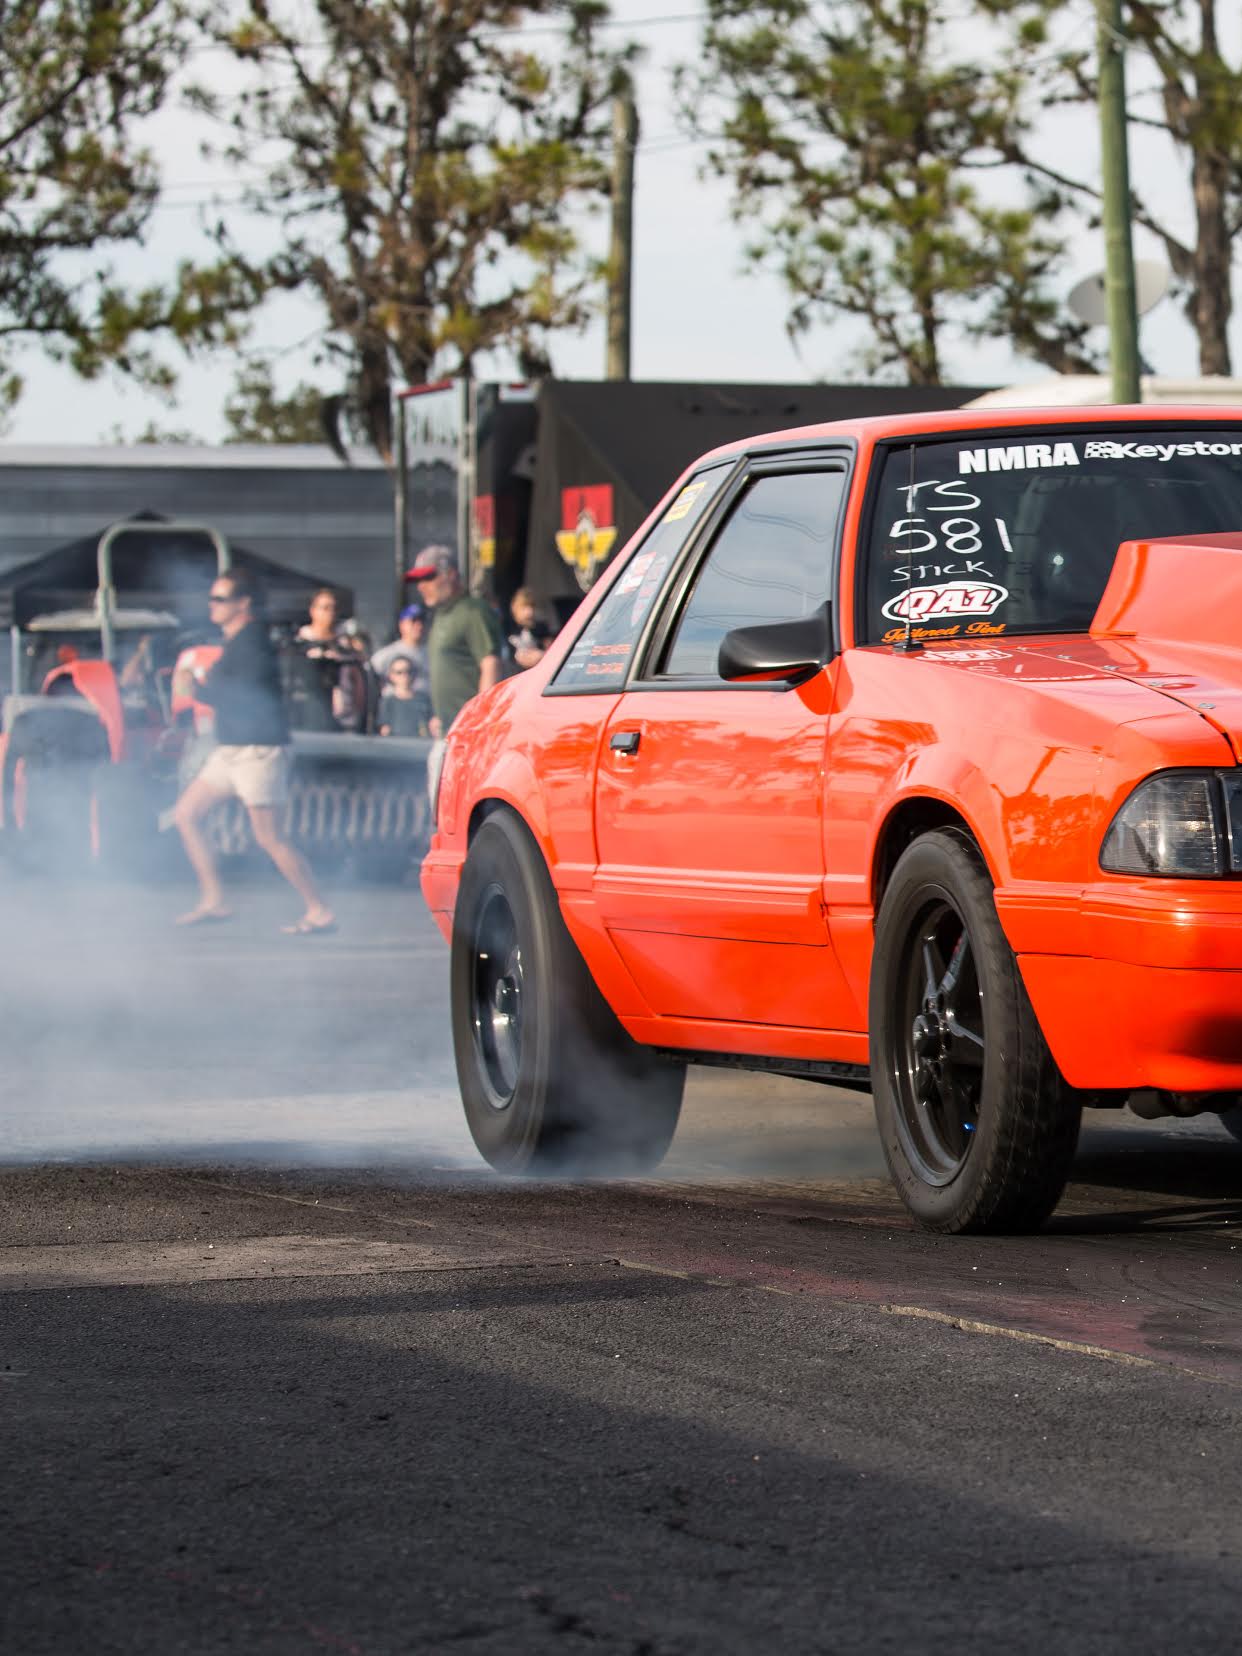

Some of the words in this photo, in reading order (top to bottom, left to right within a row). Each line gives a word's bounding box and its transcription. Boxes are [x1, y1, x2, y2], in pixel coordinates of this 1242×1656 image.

[958, 442, 1081, 474] NMRA
[896, 480, 982, 512] TS
[889, 517, 1014, 554] 581
[890, 560, 995, 582] STICK
[897, 588, 993, 621] QA1
[964, 621, 1007, 635] Tint
